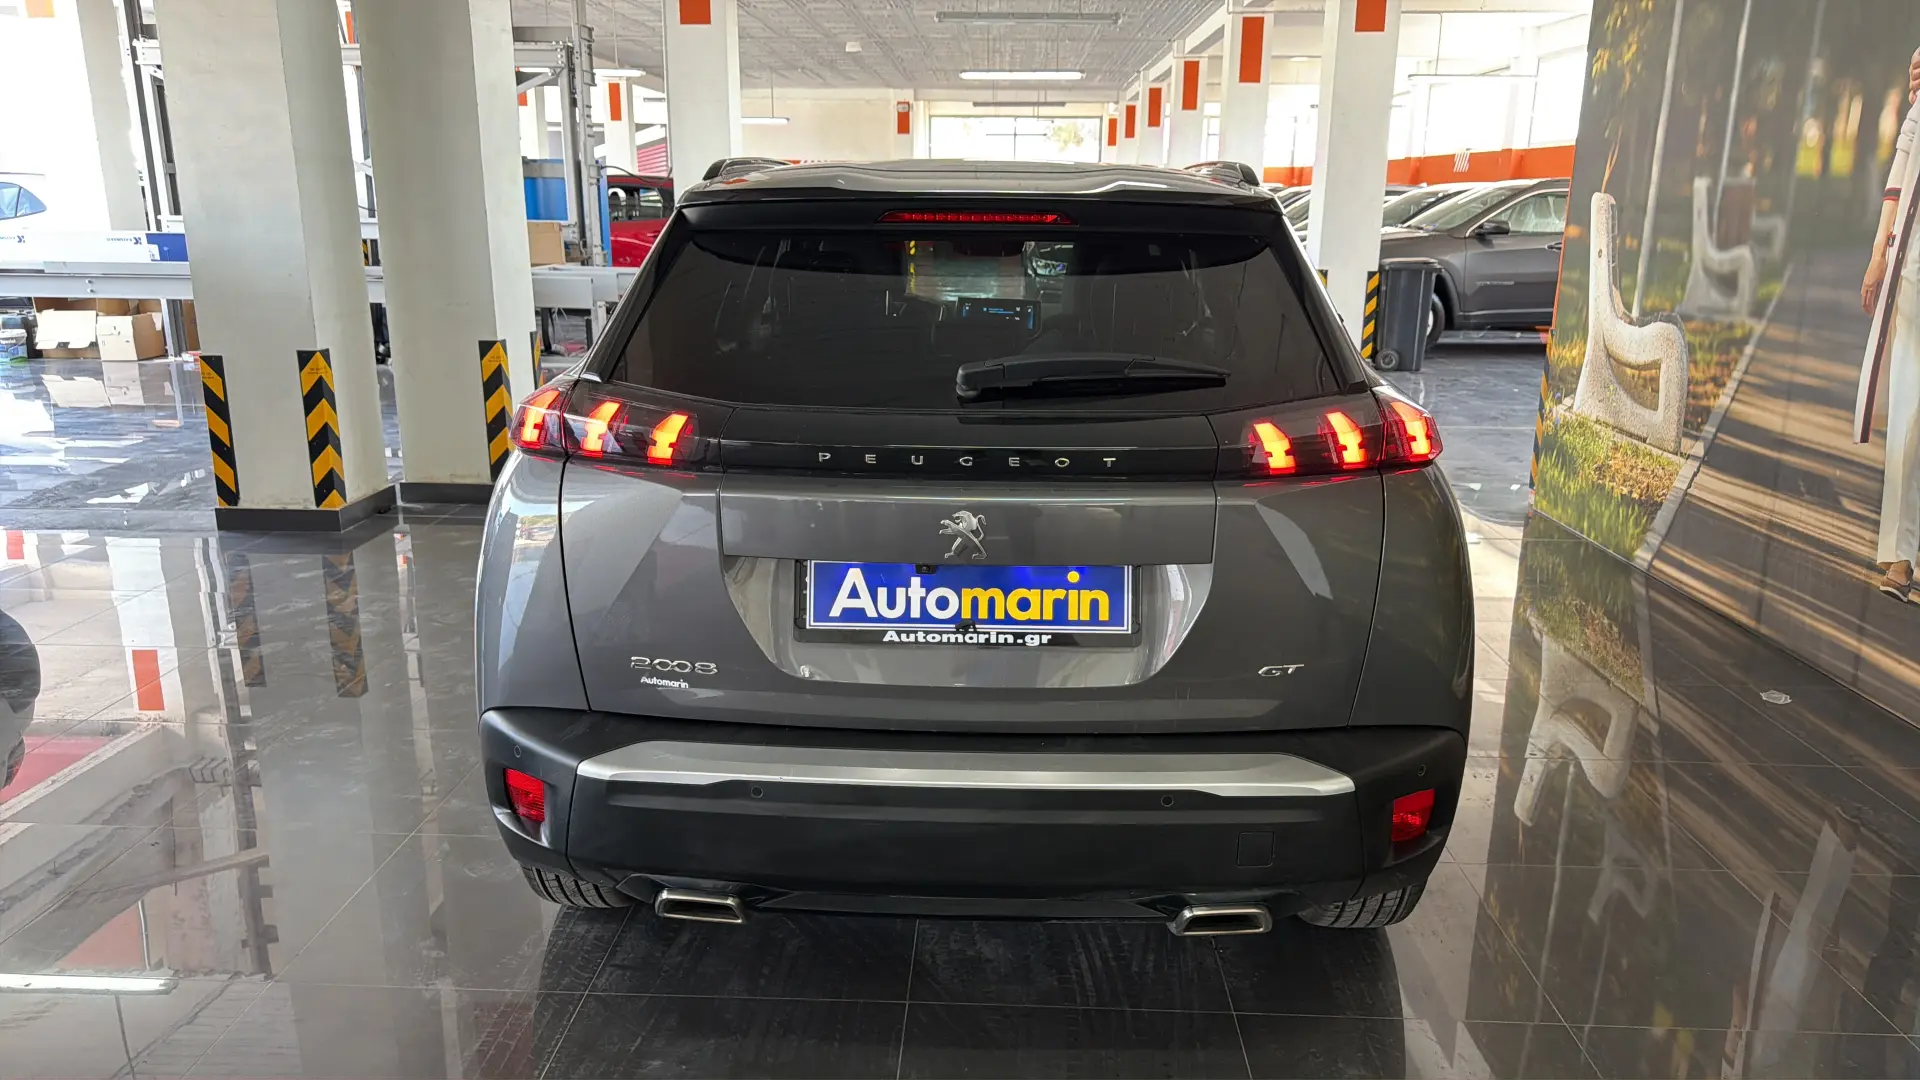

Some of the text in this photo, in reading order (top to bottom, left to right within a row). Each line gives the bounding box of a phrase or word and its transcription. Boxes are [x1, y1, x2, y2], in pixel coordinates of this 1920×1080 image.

[818, 452, 1116, 467] PEUGEOT
[828, 567, 1110, 621] Automarin
[883, 630, 1051, 647] Automarin.gr
[630, 656, 719, 675] 2008
[1258, 663, 1305, 677] GT
[640, 676, 689, 689] Automarin
